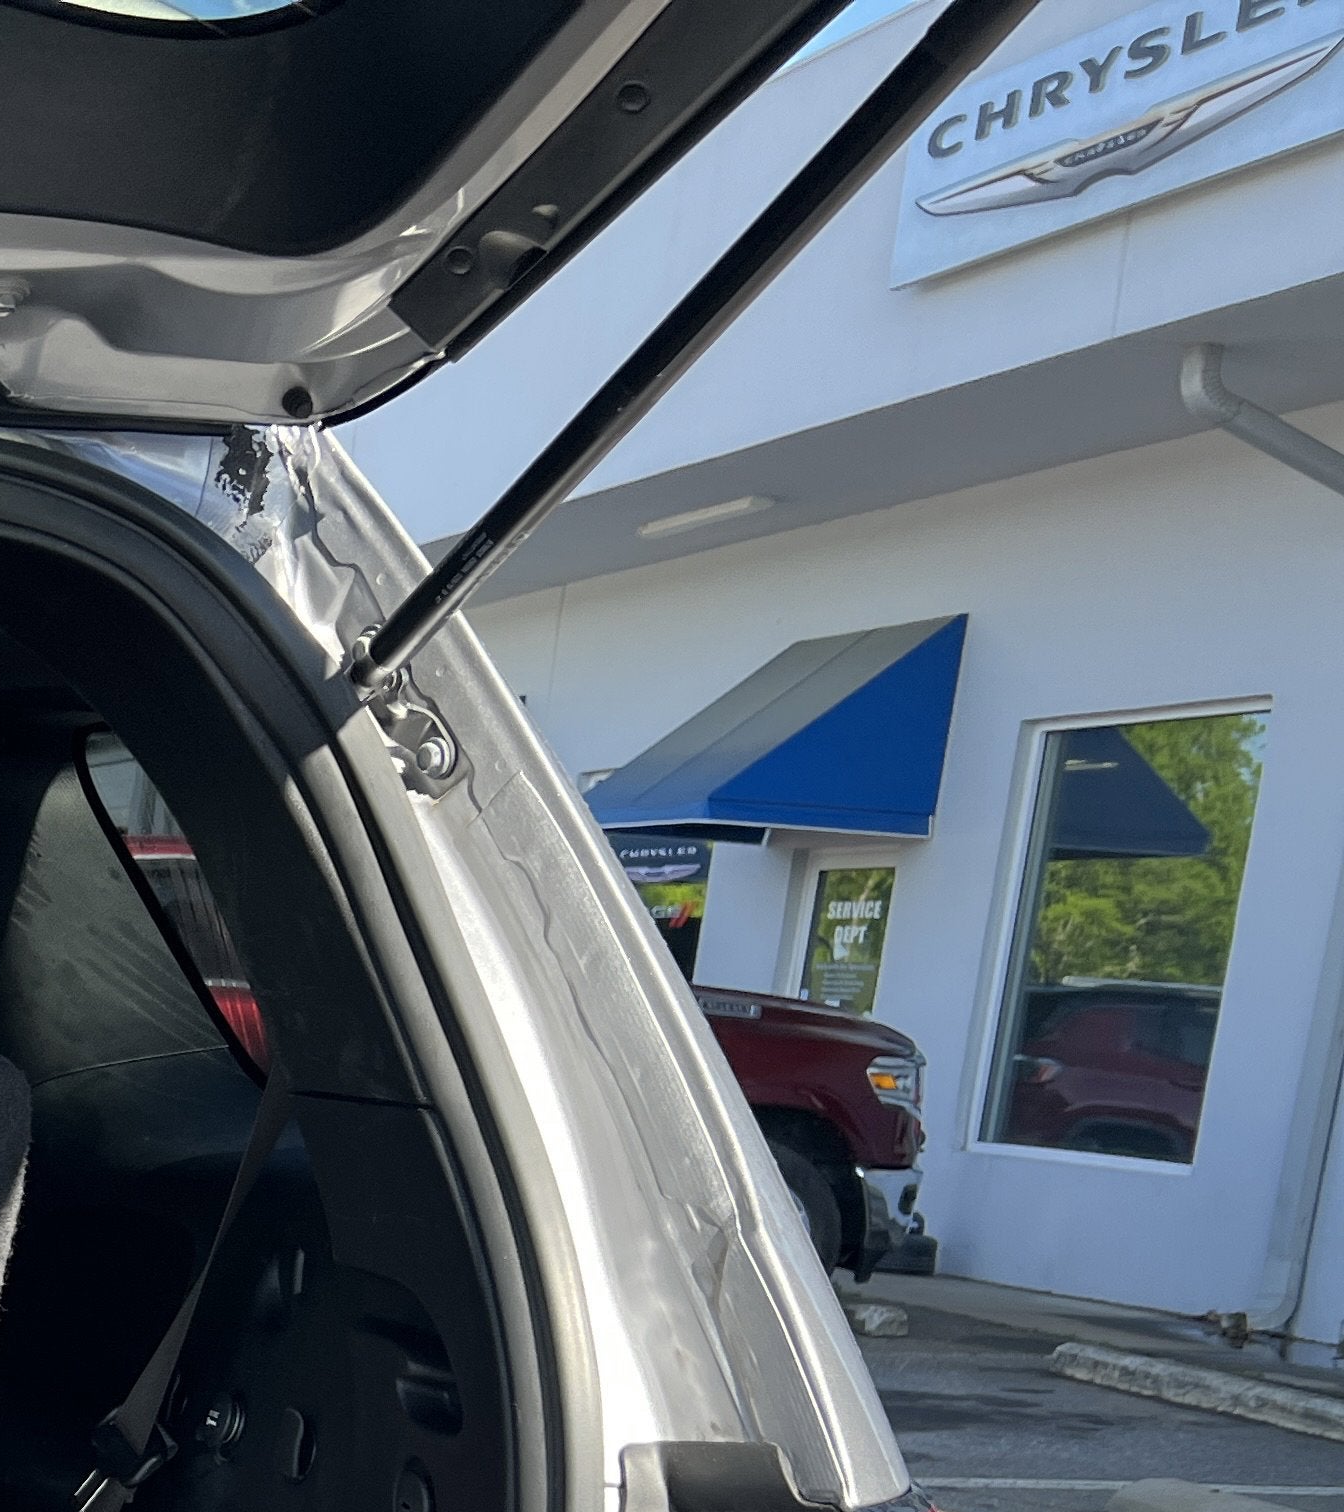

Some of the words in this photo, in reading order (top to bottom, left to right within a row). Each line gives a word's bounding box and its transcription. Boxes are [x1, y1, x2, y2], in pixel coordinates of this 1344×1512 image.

[927, 0, 1316, 159] CHRYSLE
[827, 900, 882, 920] SERVICE
[834, 925, 868, 944] DEPT
